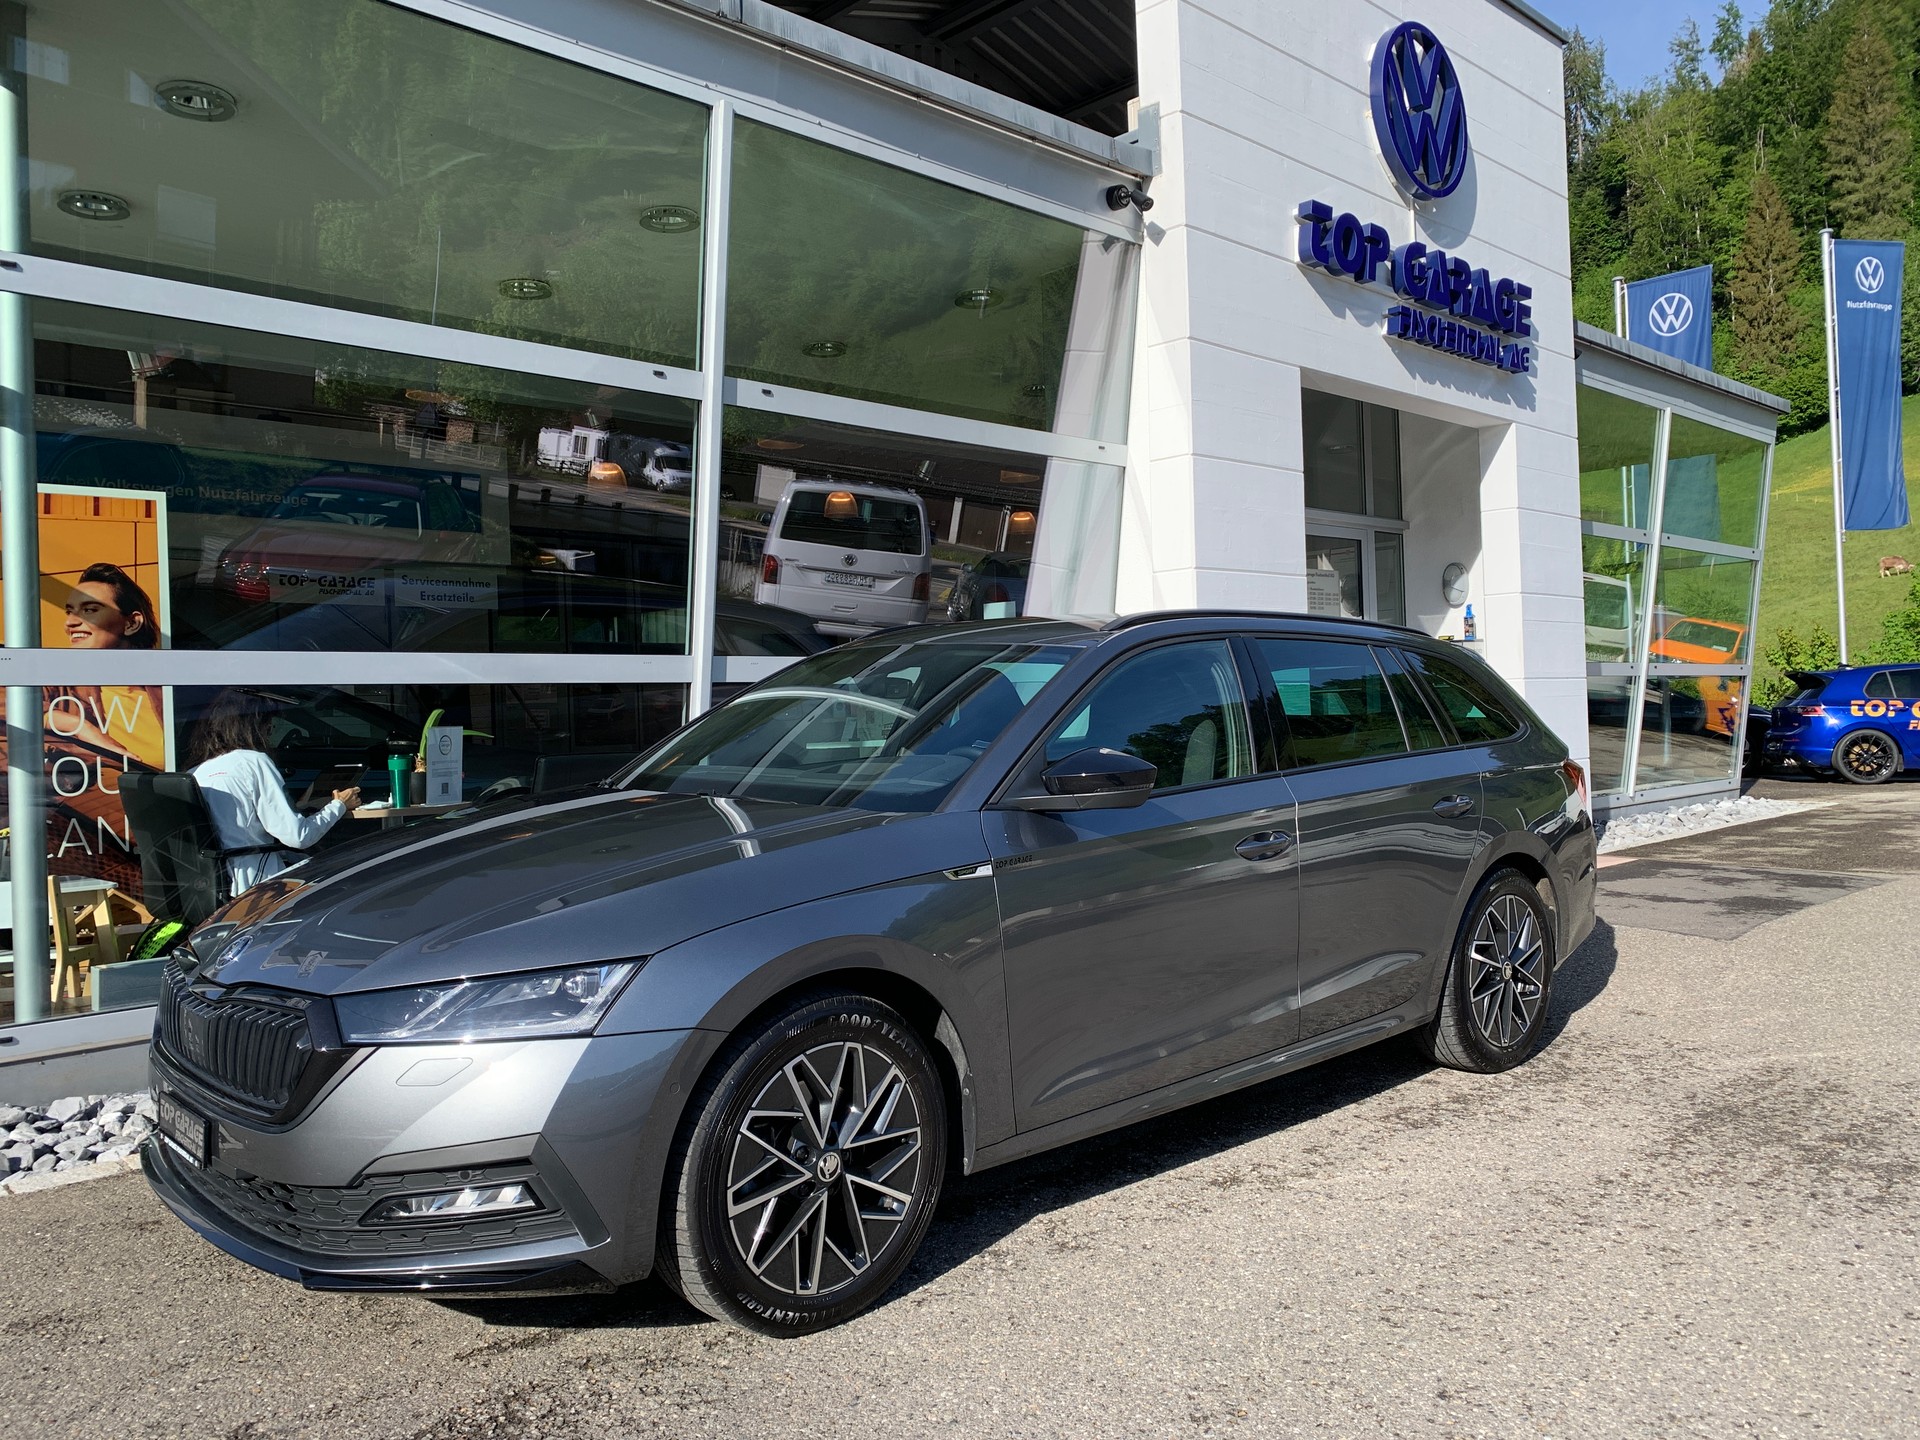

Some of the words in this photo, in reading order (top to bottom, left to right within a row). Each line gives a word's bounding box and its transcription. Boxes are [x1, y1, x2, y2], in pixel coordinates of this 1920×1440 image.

[1298, 199, 1390, 284] TOP
[1391, 241, 1533, 340] GARAGE
[1500, 343, 1530, 375] AG
[198, 485, 309, 508] Nutzfahrzeuge
[401, 575, 492, 589] Serviceannahme
[420, 591, 475, 603] Ersatzteile
[49, 695, 143, 737] OW
[1850, 699, 1905, 717] TOP
[44, 755, 129, 797] OU
[47, 814, 130, 859] AN
[160, 1099, 175, 1124] TOP
